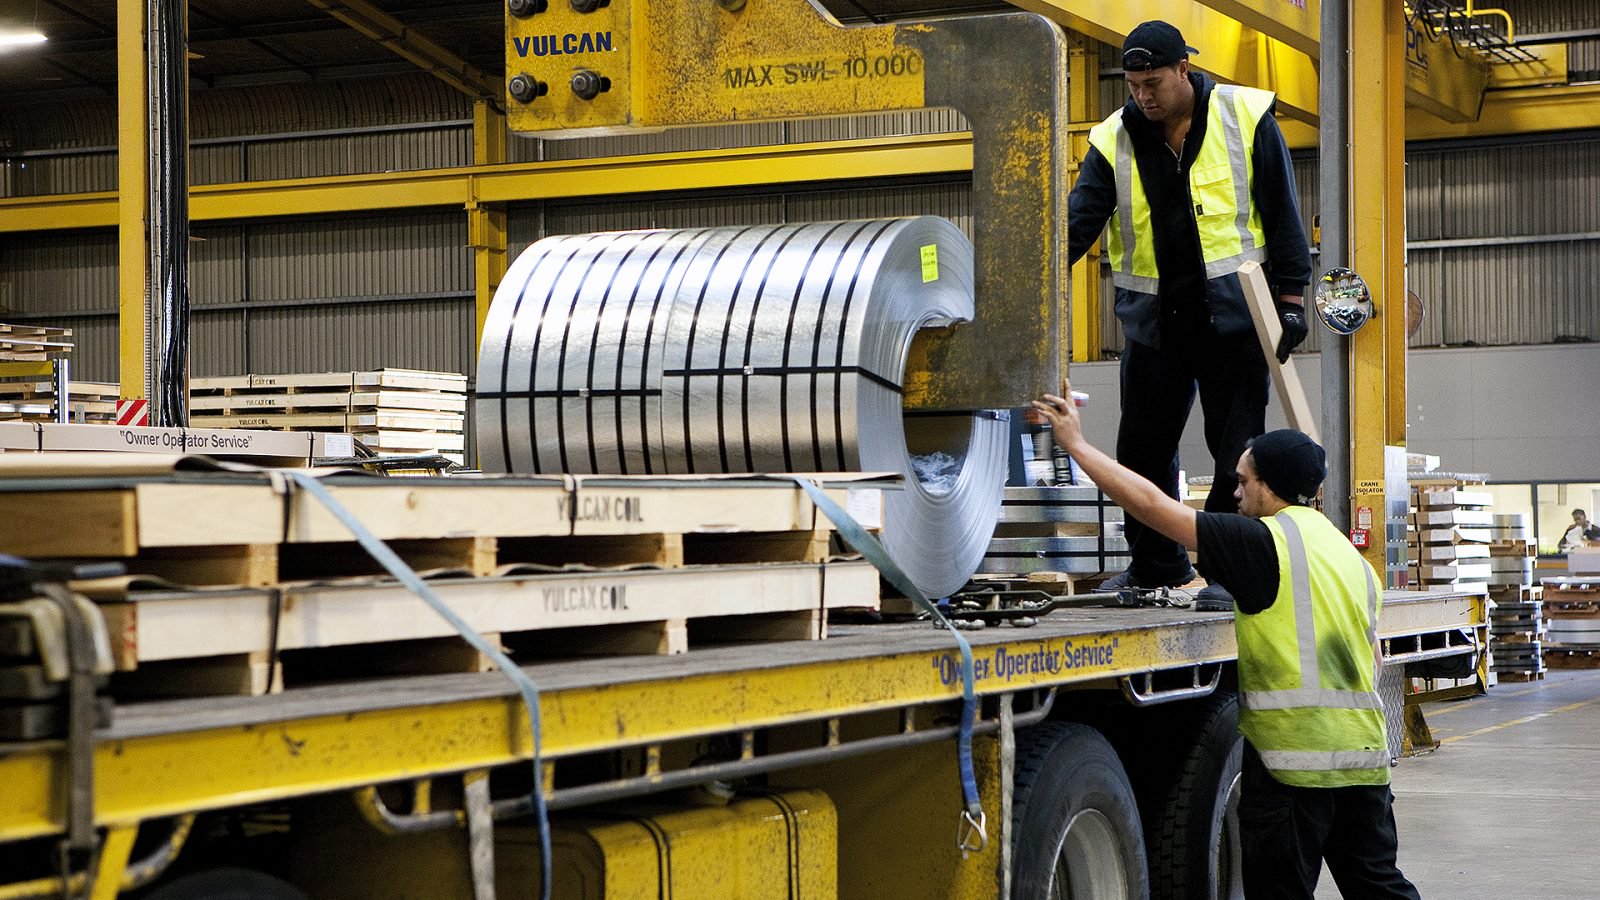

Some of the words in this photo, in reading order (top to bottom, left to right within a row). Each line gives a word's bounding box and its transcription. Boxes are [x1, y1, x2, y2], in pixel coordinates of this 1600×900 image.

[513, 31, 612, 58] VULCAN
[724, 64, 774, 89] MAX
[843, 53, 921, 82] 10,000
[995, 645, 1060, 682] Operator
[1065, 637, 1119, 670] Service"
